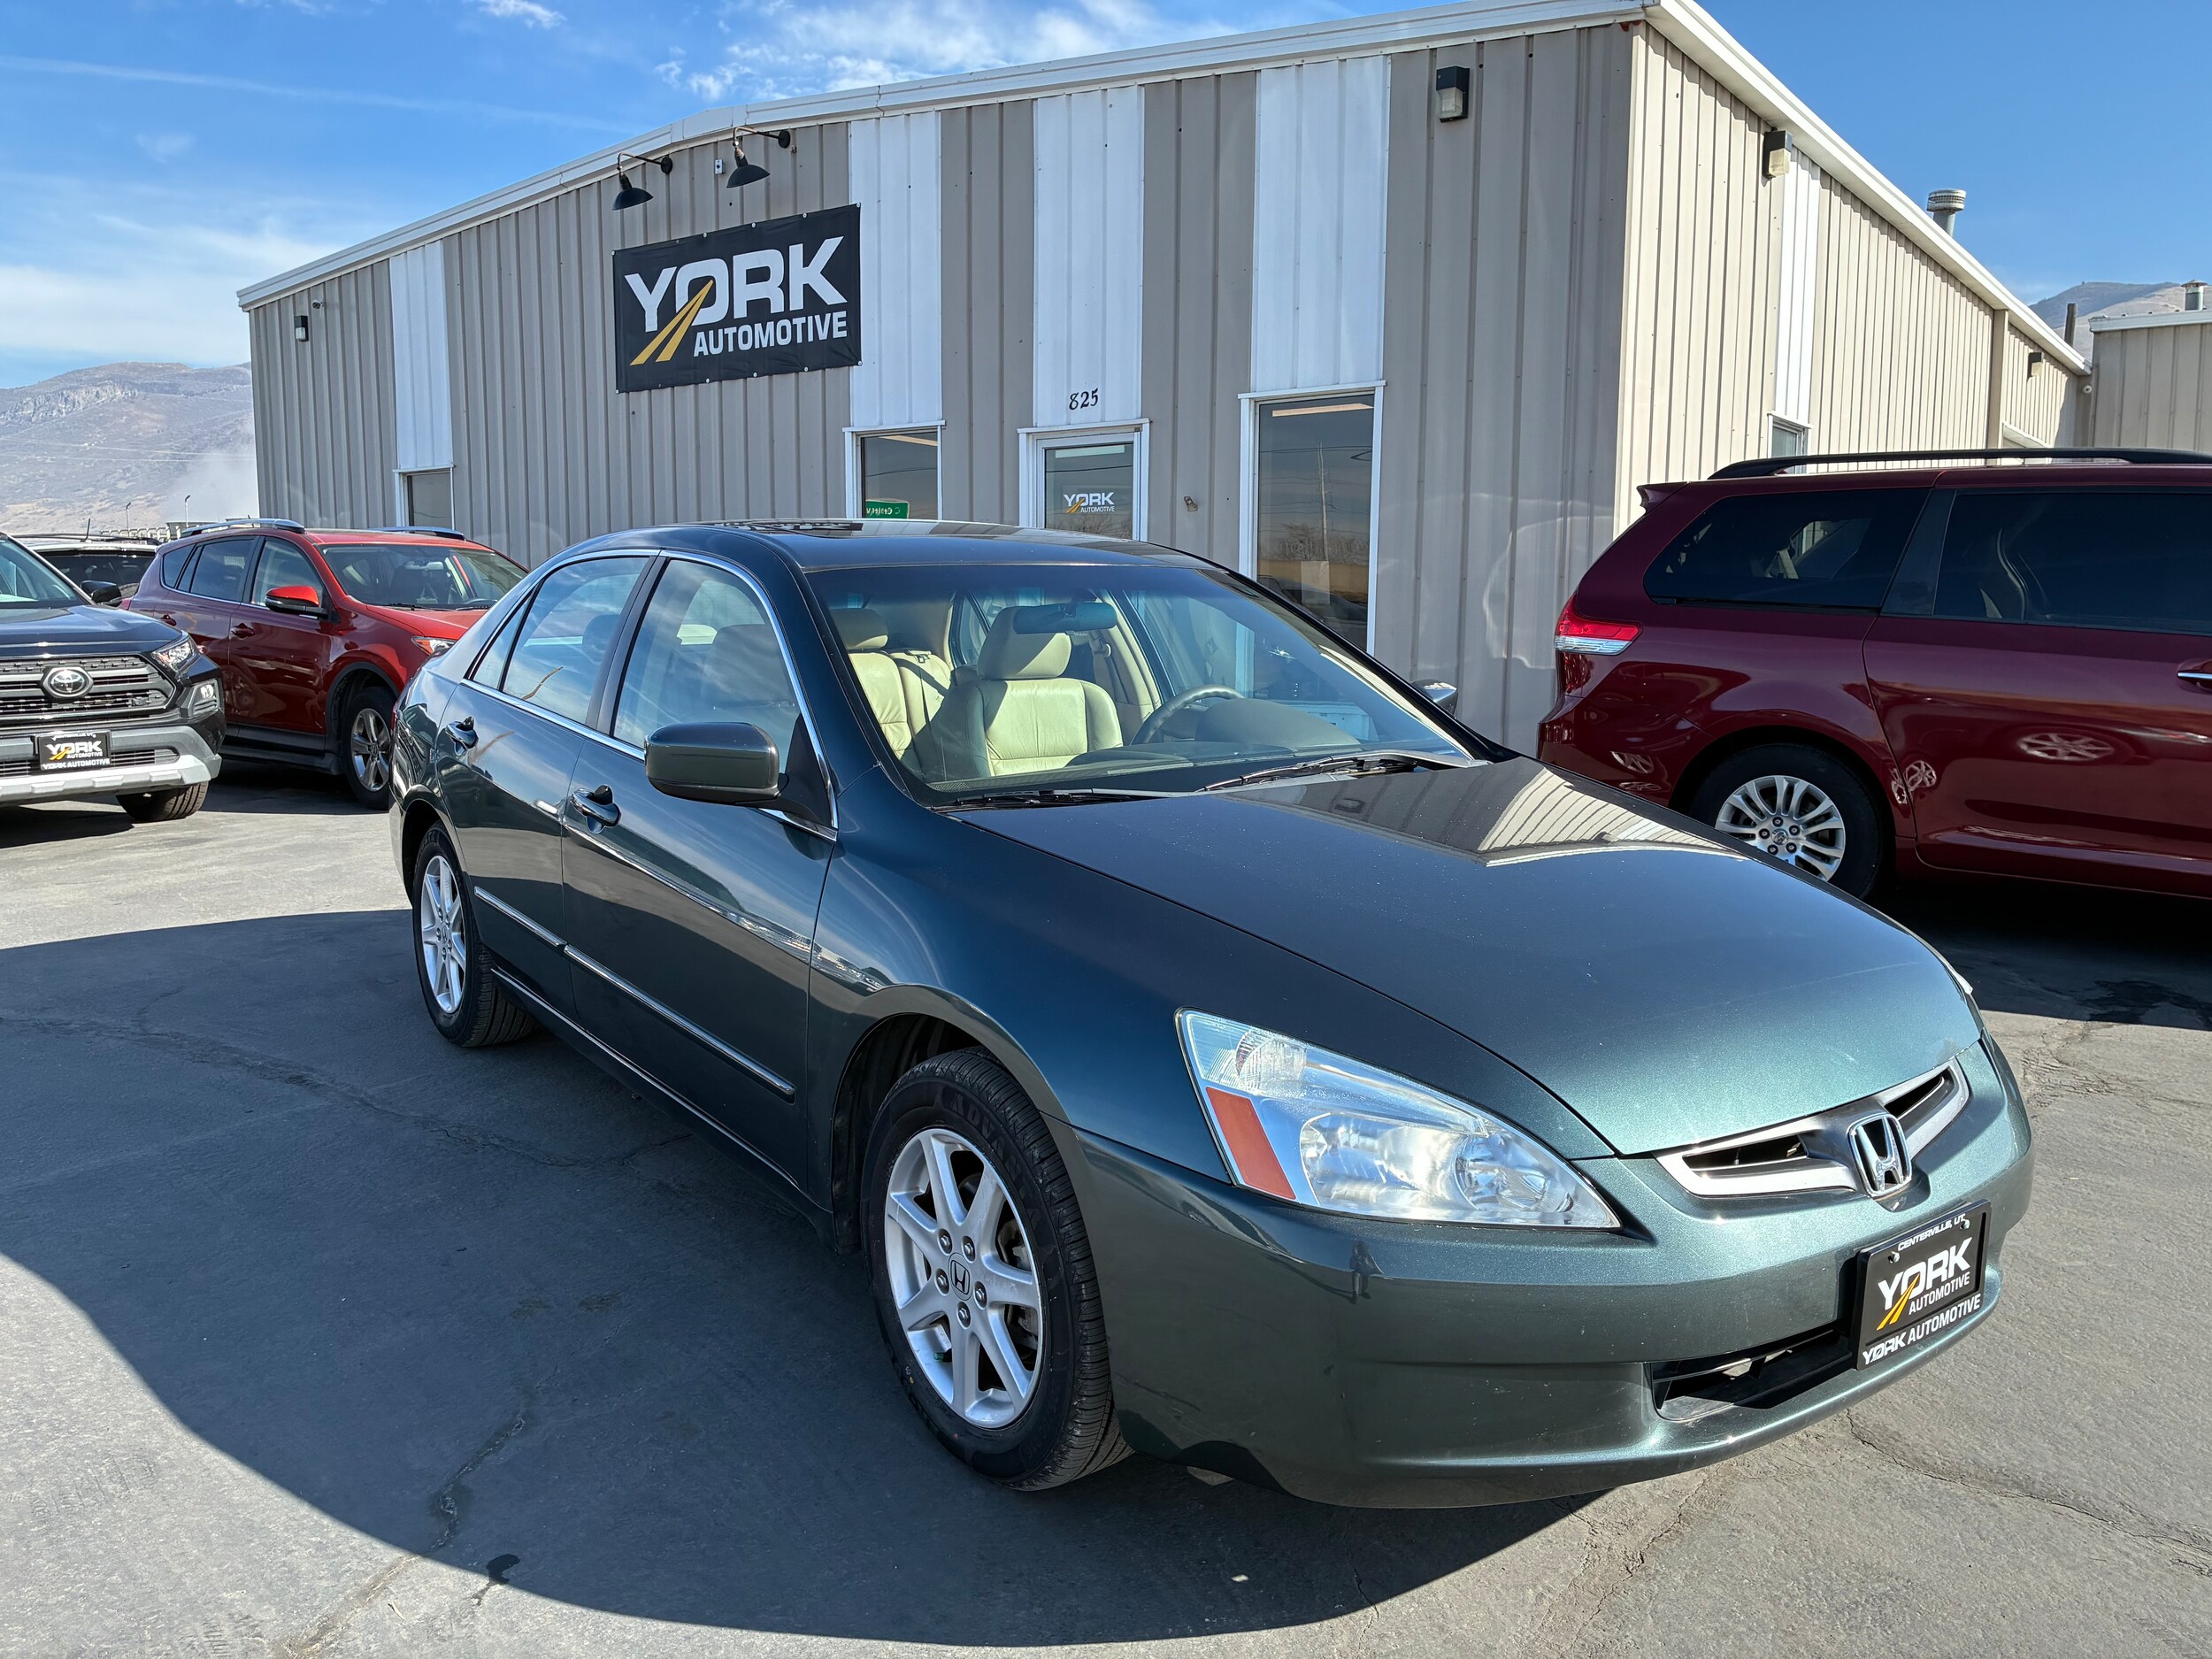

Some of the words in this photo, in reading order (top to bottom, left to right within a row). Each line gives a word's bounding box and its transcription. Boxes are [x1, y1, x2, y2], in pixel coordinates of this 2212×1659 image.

[624, 235, 848, 333] YORK
[694, 310, 848, 357] AUTOMOTIVE
[1069, 388, 1099, 411] 825
[1063, 491, 1115, 507] YORK
[45, 741, 103, 755] YORK
[67, 758, 111, 768] AUTOMOTIVE
[1897, 1219, 1953, 1251] CENTERVILLE,
[1878, 1237, 1972, 1311] YORK
[1909, 1271, 1970, 1316] AUTOMOTIVE
[1862, 1332, 1908, 1365] YORK
[1908, 1294, 1981, 1345] AUTOMOTIVE
